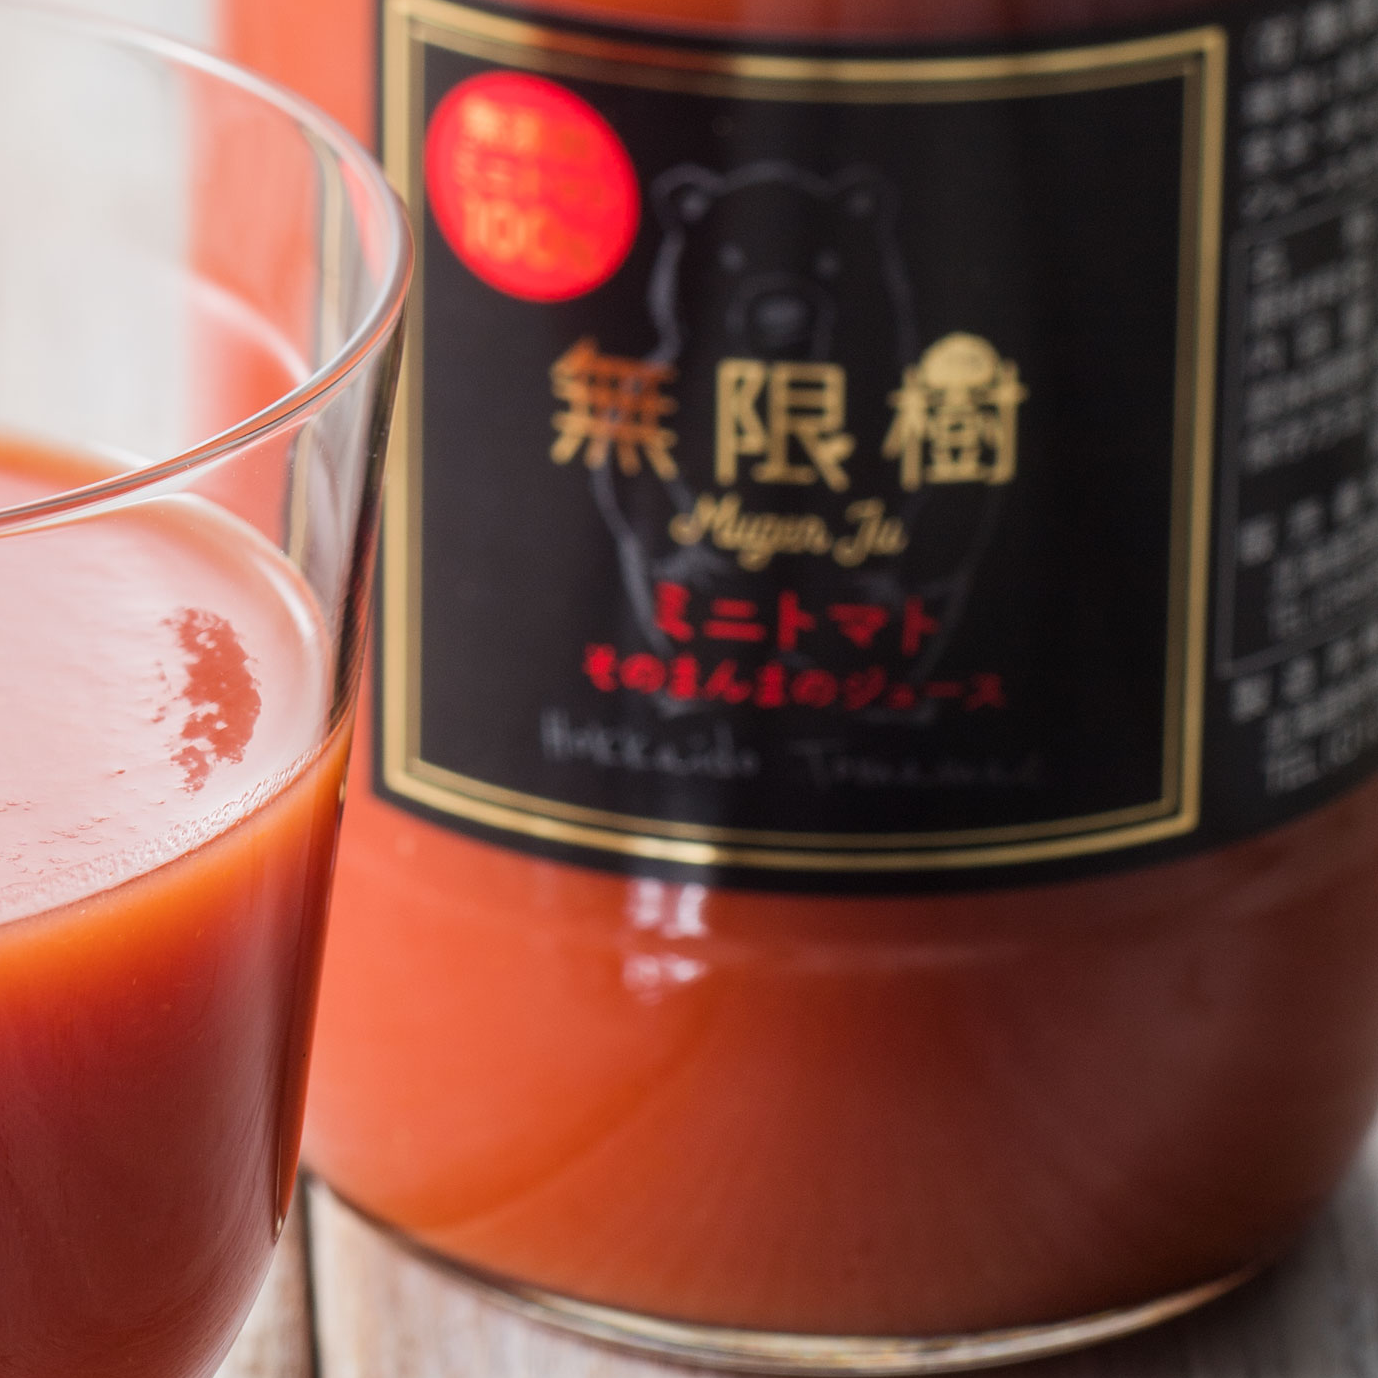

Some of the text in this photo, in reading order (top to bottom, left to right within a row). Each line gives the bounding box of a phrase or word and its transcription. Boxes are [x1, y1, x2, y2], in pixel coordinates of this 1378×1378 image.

[549, 331, 1028, 491] 無限樹
[669, 492, 910, 570] Mugen Ju
[654, 580, 940, 657] ミニトマト
